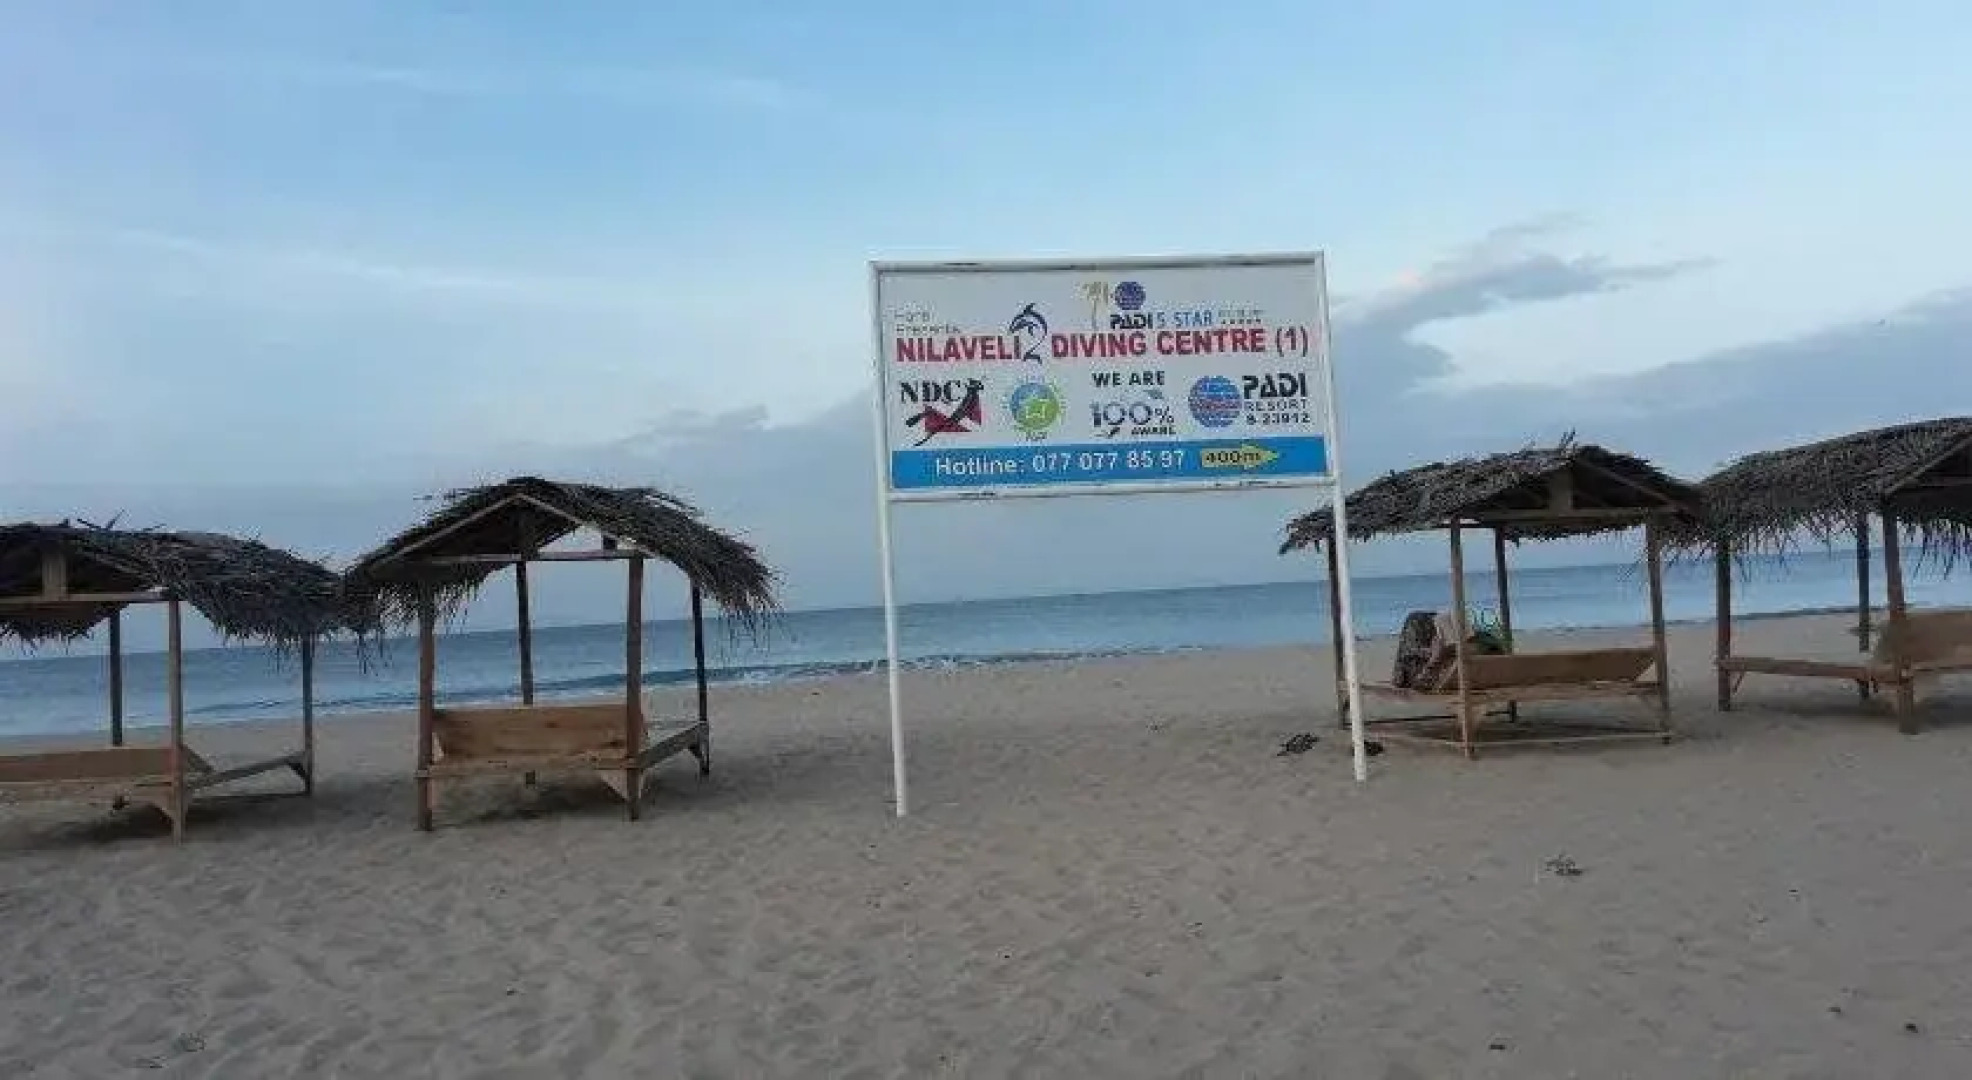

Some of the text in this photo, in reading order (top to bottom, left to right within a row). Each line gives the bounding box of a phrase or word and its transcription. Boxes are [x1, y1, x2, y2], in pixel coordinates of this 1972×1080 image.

[1110, 311, 1154, 329] PADI
[1173, 309, 1213, 327] STAR
[896, 325, 1309, 362] NILAVELI DIVING CENTRE (1)
[1092, 370, 1166, 388] WE ARE
[1242, 372, 1307, 399] PADI
[901, 379, 961, 403] NDC
[1090, 400, 1176, 428] 100%
[1244, 399, 1308, 412] RESORT
[1131, 425, 1177, 436] AWARE
[936, 449, 1185, 477] Hotline: 077 077 85 97
[1205, 449, 1262, 464] 400m
